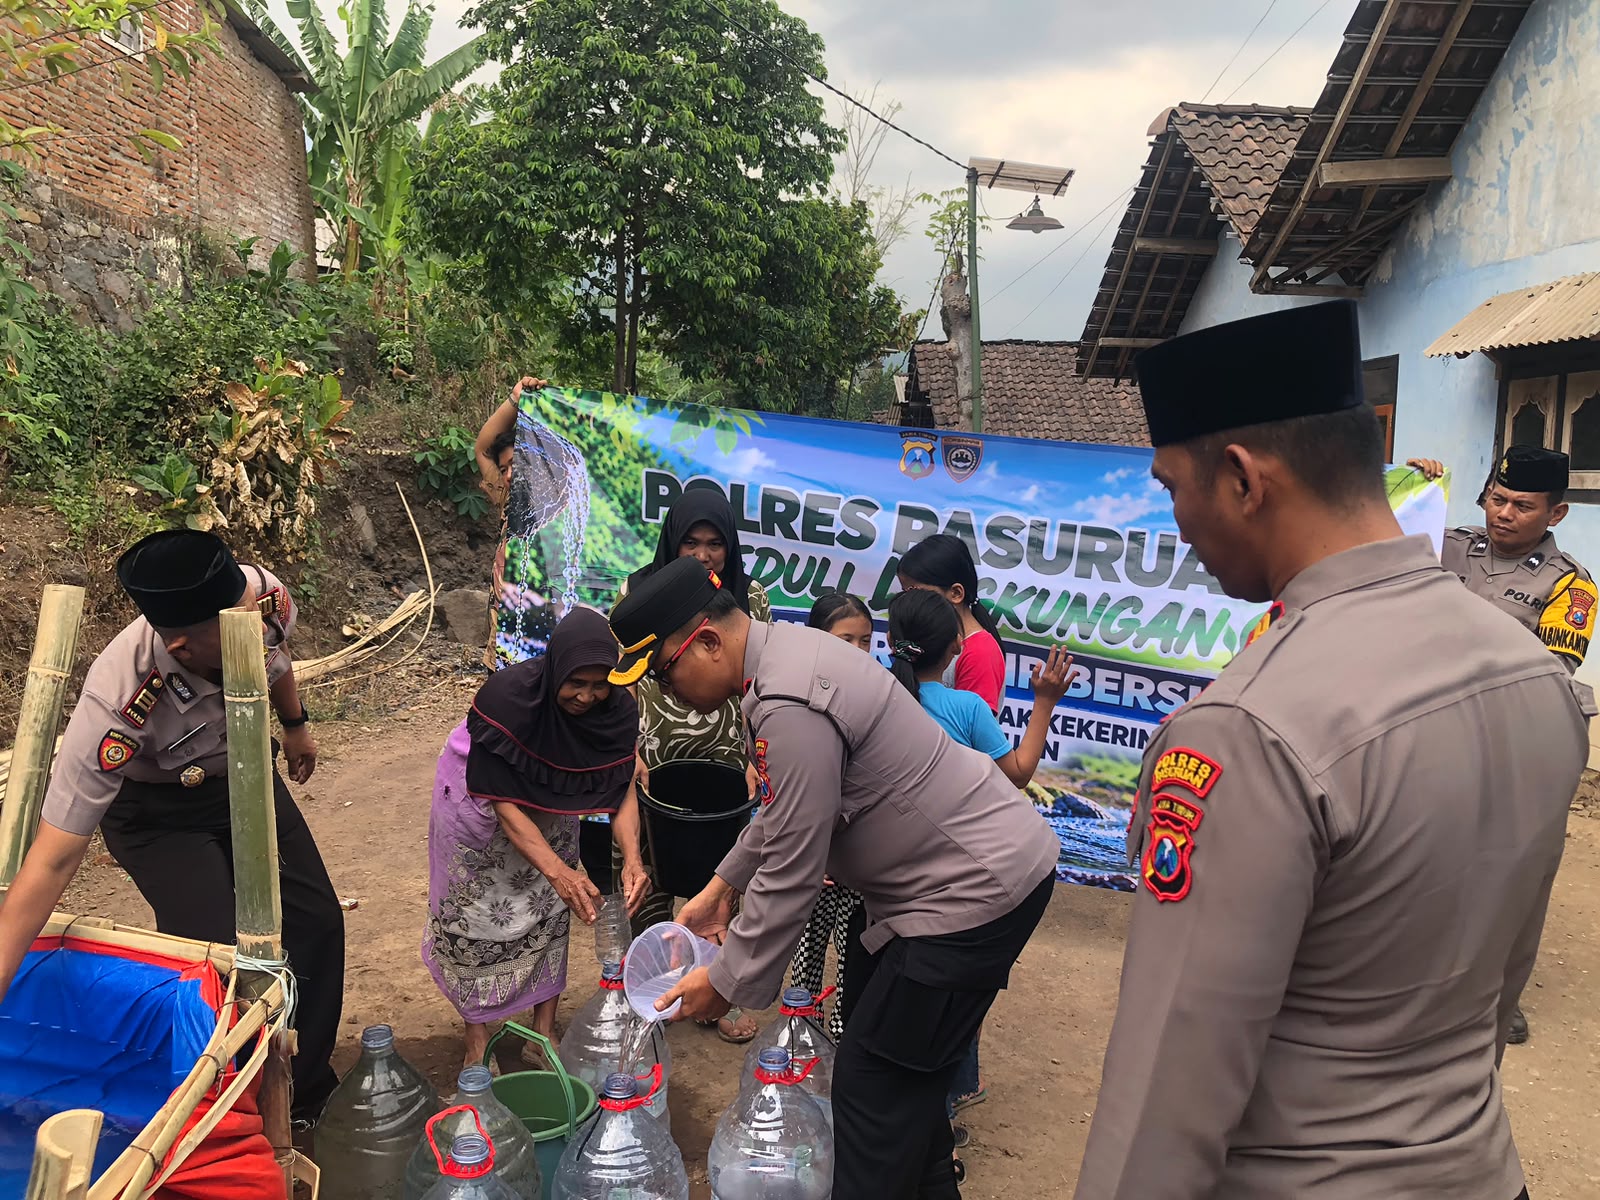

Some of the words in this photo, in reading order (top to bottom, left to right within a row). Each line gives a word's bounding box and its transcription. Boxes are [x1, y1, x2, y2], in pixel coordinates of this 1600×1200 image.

[643, 470, 878, 551] PLRES
[892, 503, 1226, 596] PASURUA
[740, 544, 856, 598] DULI
